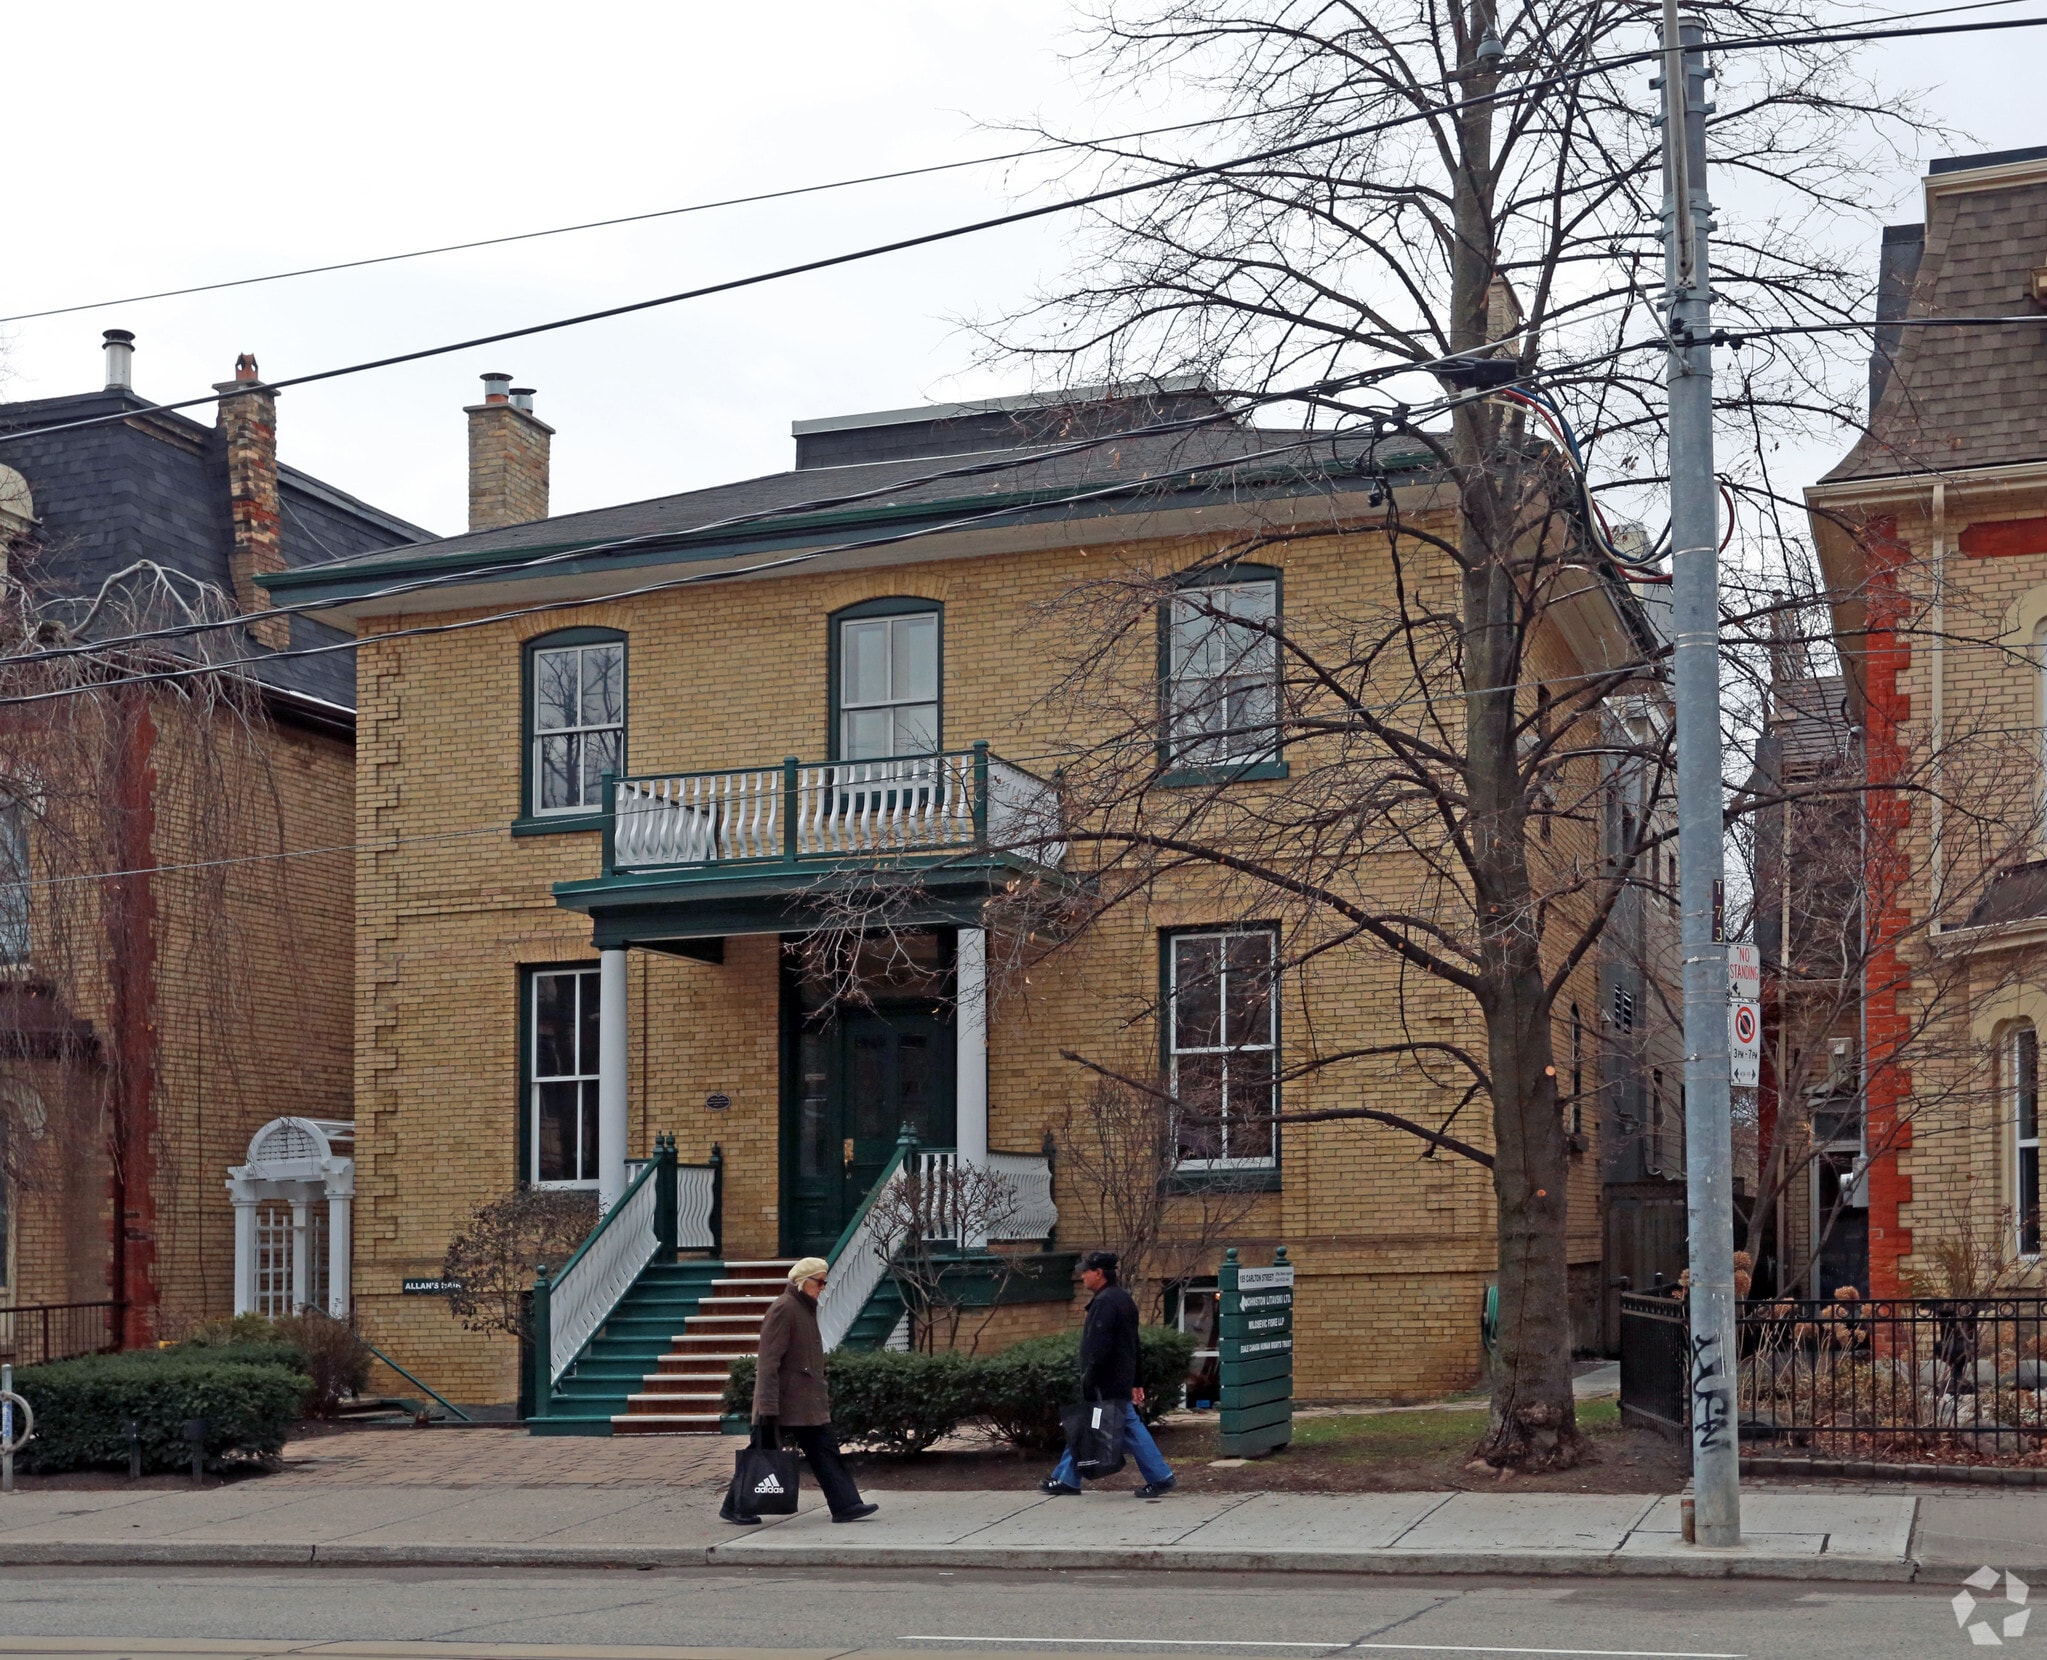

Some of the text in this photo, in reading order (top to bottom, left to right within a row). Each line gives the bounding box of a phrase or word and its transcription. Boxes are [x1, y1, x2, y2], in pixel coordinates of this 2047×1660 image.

[1739, 947, 1750, 962] NO
[1729, 964, 1759, 980] STANDING
[1246, 1274, 1261, 1282] CARLTON
[1262, 1273, 1274, 1281] STREET
[405, 1282, 439, 1290] ALLAN'S
[754, 1486, 784, 1494] adidas
